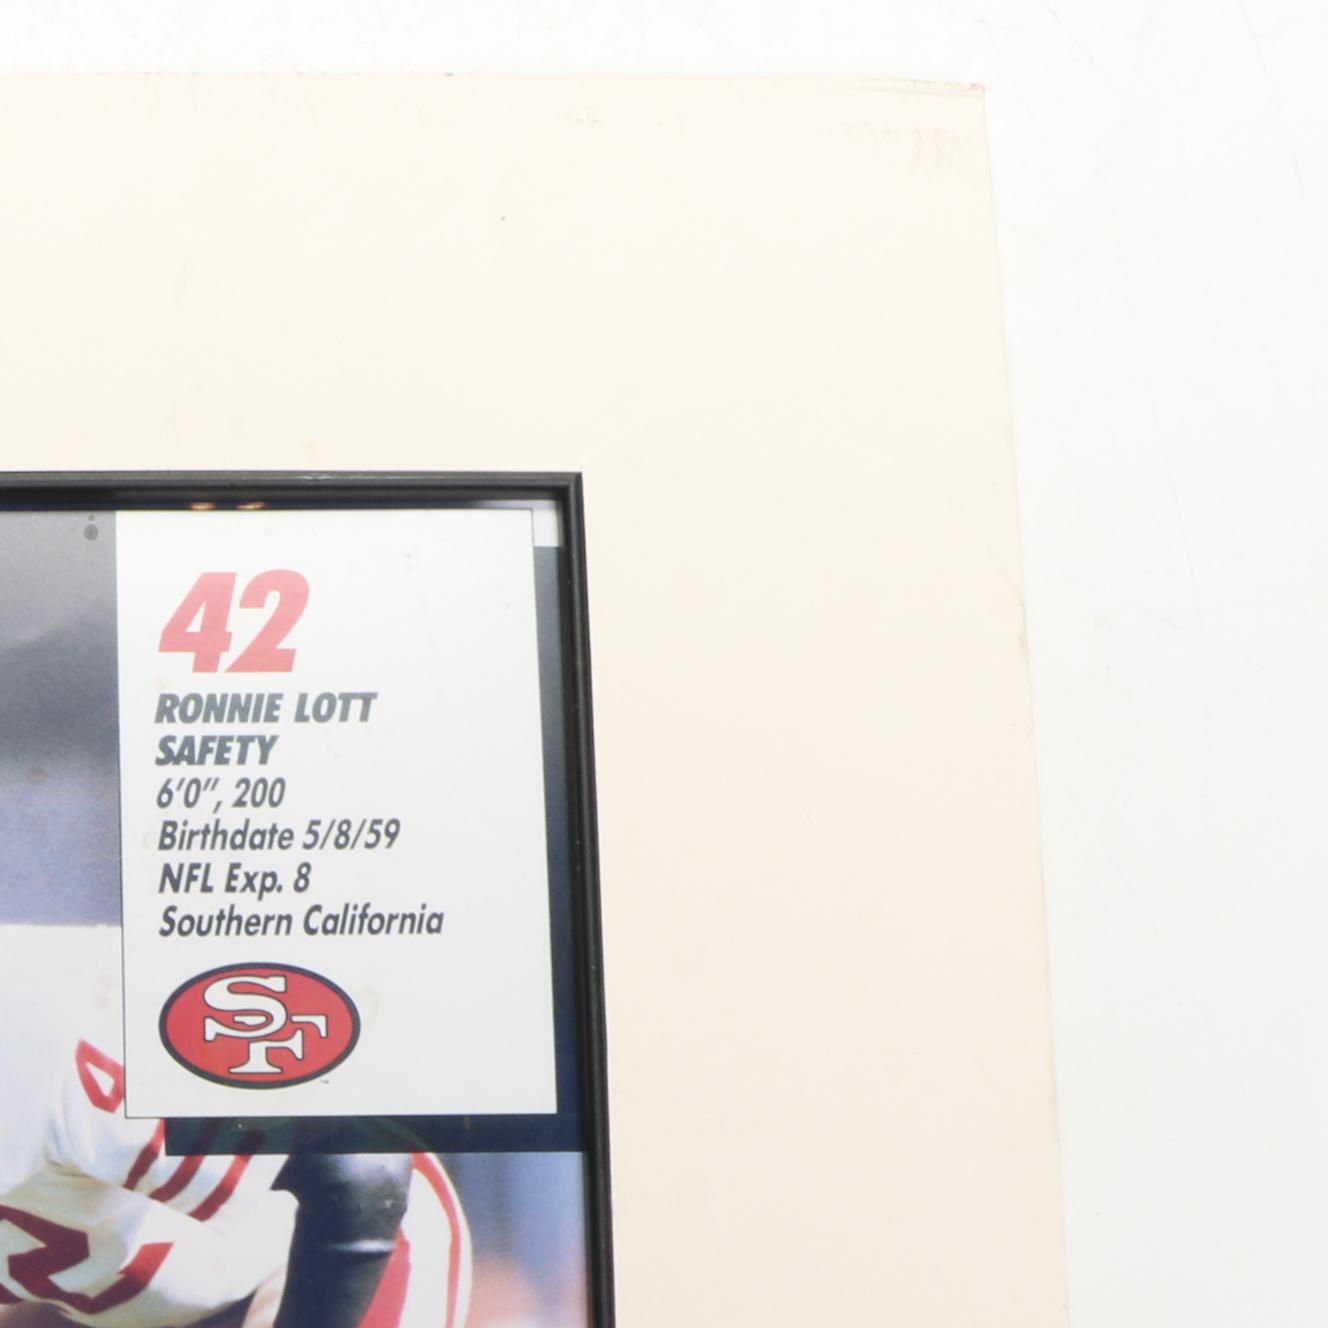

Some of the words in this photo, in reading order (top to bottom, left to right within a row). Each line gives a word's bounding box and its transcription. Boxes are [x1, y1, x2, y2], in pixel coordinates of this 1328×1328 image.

[158, 569, 310, 673] 42
[154, 692, 284, 725] RONNIE
[294, 691, 378, 724] LOTT
[154, 734, 280, 767] SAFETY
[231, 776, 287, 808] 200
[157, 817, 294, 852] Birthdate
[301, 817, 402, 851] 5/8/59
[158, 862, 214, 894] NFL
[224, 862, 284, 901] Exp.
[292, 861, 313, 894] 8
[158, 903, 293, 937] Southern
[302, 901, 445, 936] California
[203, 974, 329, 1075] SF
